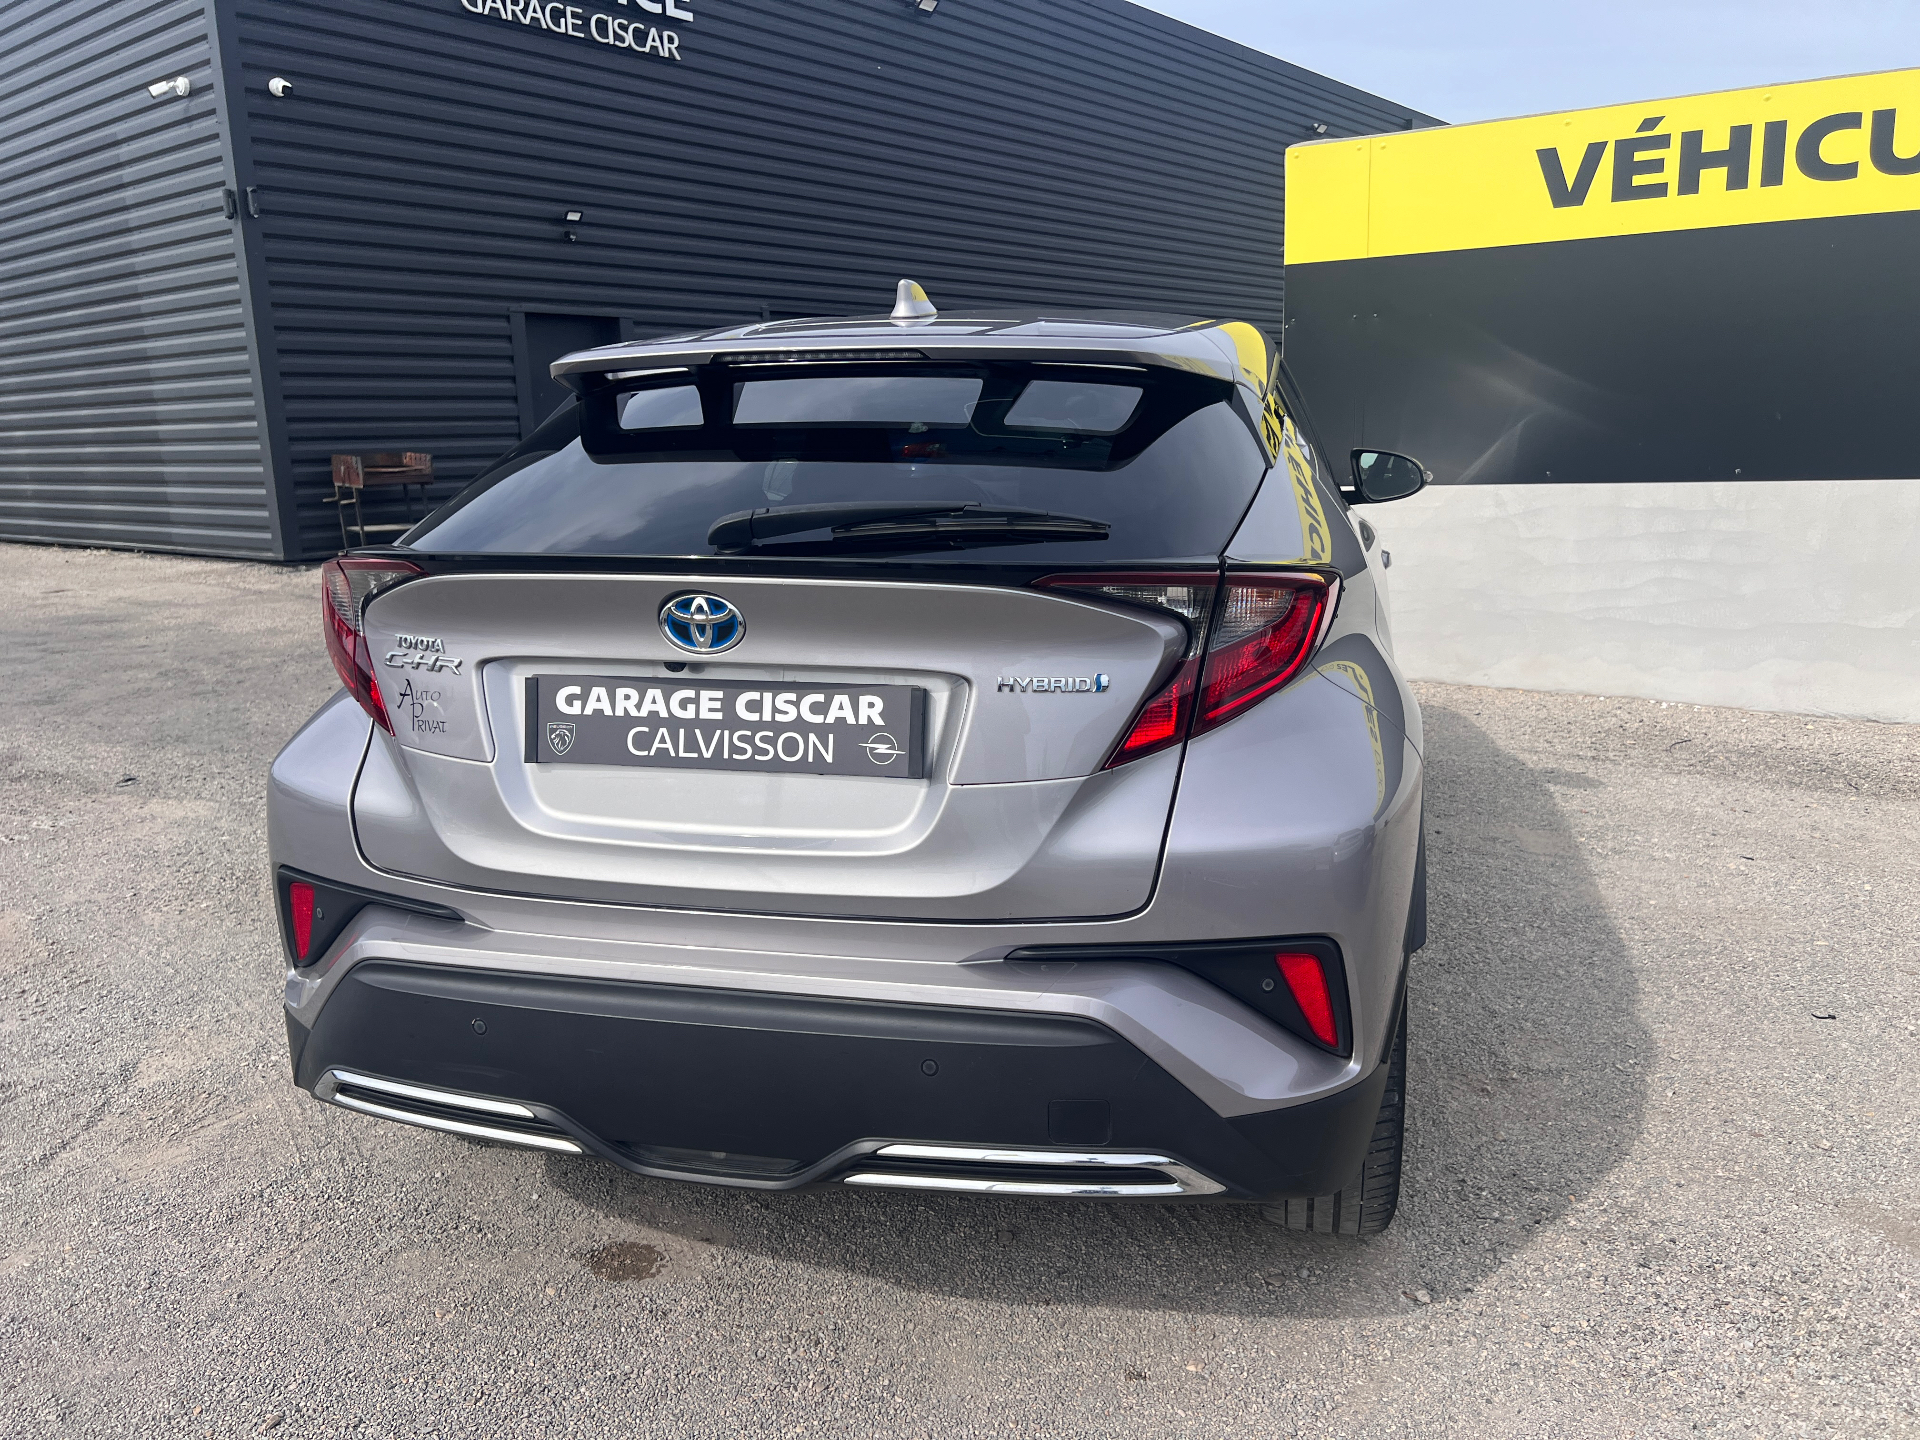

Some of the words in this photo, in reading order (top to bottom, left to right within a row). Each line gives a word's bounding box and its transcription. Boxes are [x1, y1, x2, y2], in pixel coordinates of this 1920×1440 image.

[590, 14, 682, 60] CISCAR
[1535, 108, 1920, 209] VÉHICU
[395, 633, 445, 653] TOYOTA
[384, 651, 463, 675] C-HR
[997, 676, 1091, 692] HYBRID
[555, 685, 723, 719] GARAGE
[735, 690, 886, 726] CISCAR
[626, 726, 834, 763] CALVISSON
